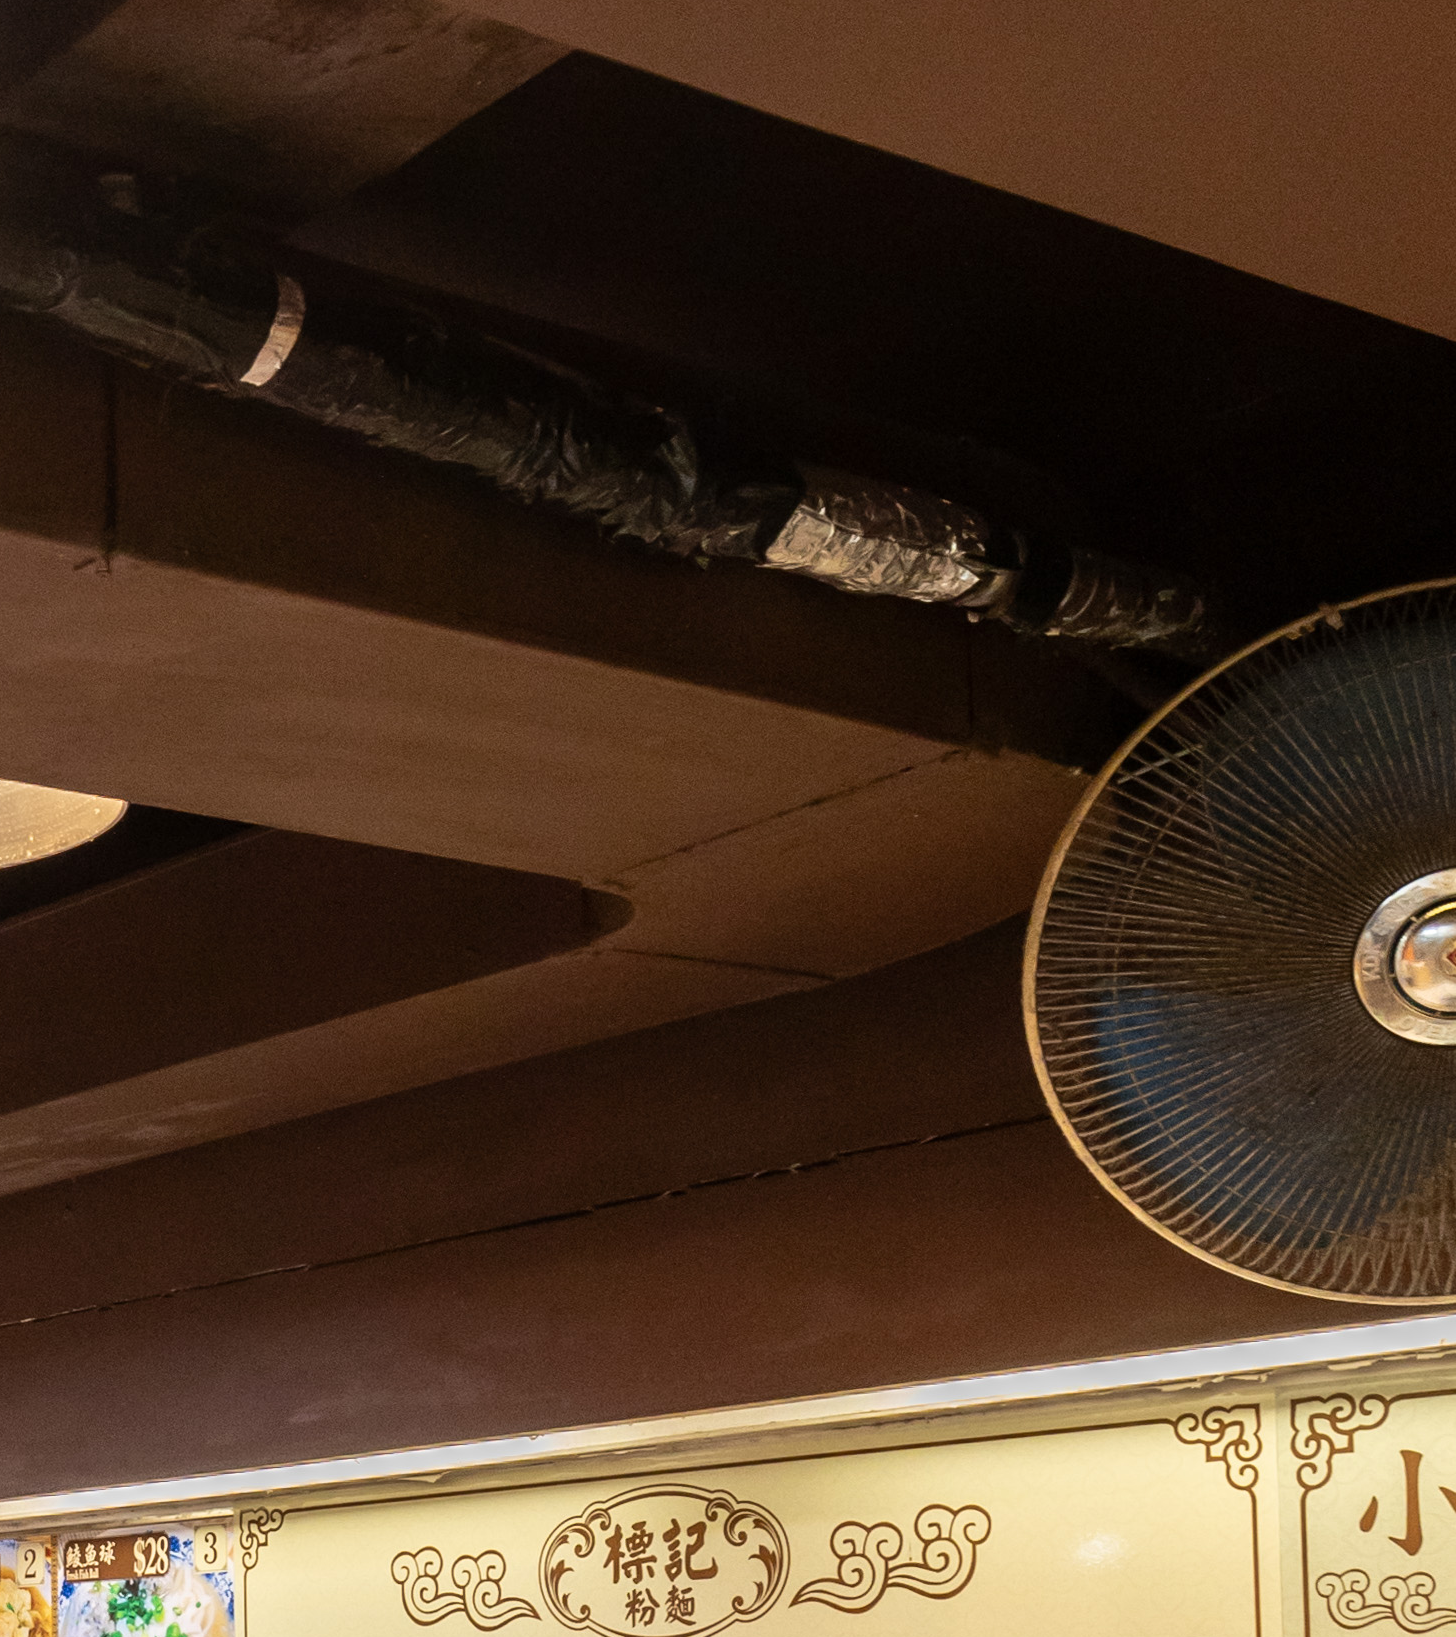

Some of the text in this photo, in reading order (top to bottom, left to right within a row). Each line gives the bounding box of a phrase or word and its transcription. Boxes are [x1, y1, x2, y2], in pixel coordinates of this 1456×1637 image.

[24, 1548, 37, 1579] 2
[65, 1535, 169, 1578] 鯪魚球 $28
[204, 1531, 217, 1565] 3
[603, 1517, 719, 1584] 標記
[624, 1584, 697, 1628] 粉麵
